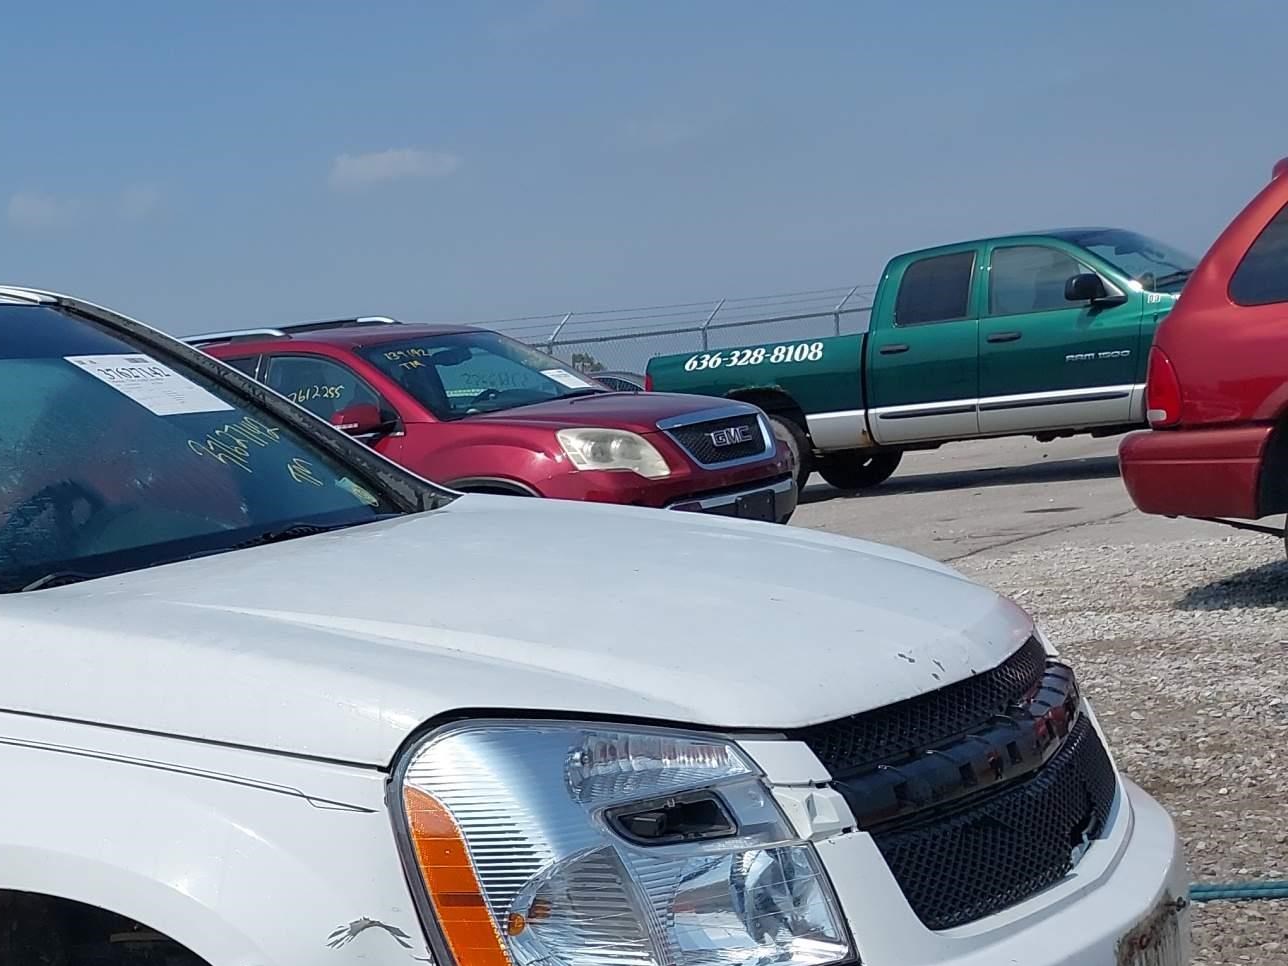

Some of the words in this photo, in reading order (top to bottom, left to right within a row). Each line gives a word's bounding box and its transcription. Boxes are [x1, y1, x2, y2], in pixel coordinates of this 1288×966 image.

[684, 342, 824, 371] 636-328-8108
[97, 366, 172, 380] 37627142
[711, 425, 753, 447] GMC
